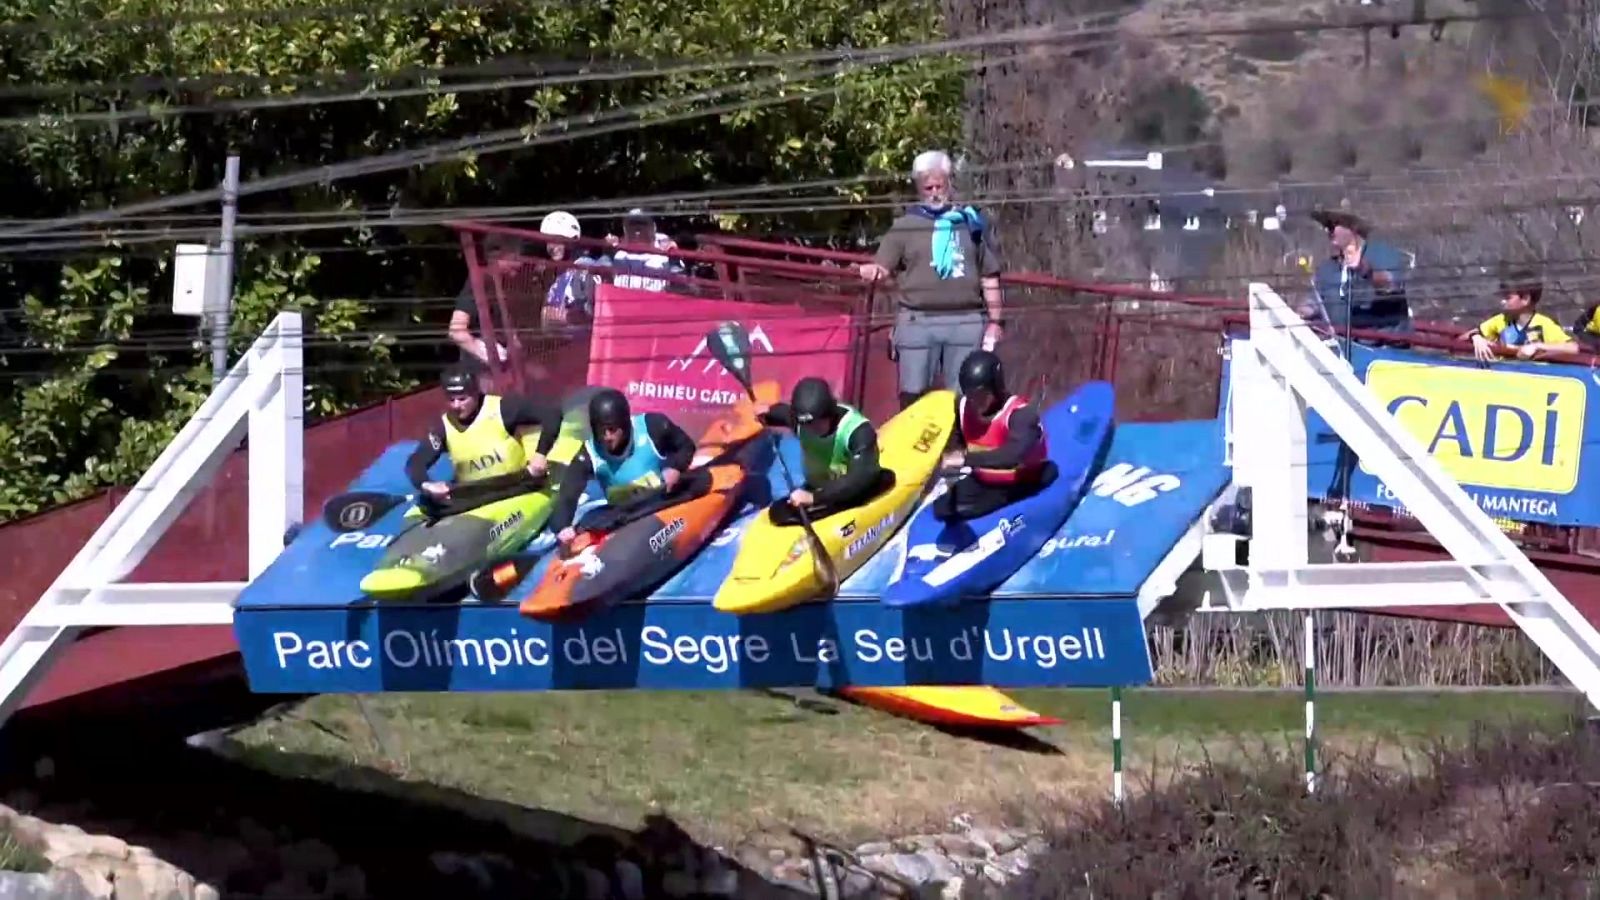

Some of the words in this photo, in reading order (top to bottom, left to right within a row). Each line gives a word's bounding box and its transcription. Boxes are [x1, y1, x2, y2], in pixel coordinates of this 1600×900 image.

[628, 381, 697, 401] PIRINEU
[1482, 493, 1558, 517] MANTEGA
[272, 631, 373, 669] Parc
[384, 628, 550, 675] Olímpic
[563, 628, 628, 666] del
[640, 625, 769, 673] Segre
[790, 631, 838, 663] La
[854, 629, 933, 663] Seu
[949, 626, 1106, 668] d'Urgell
